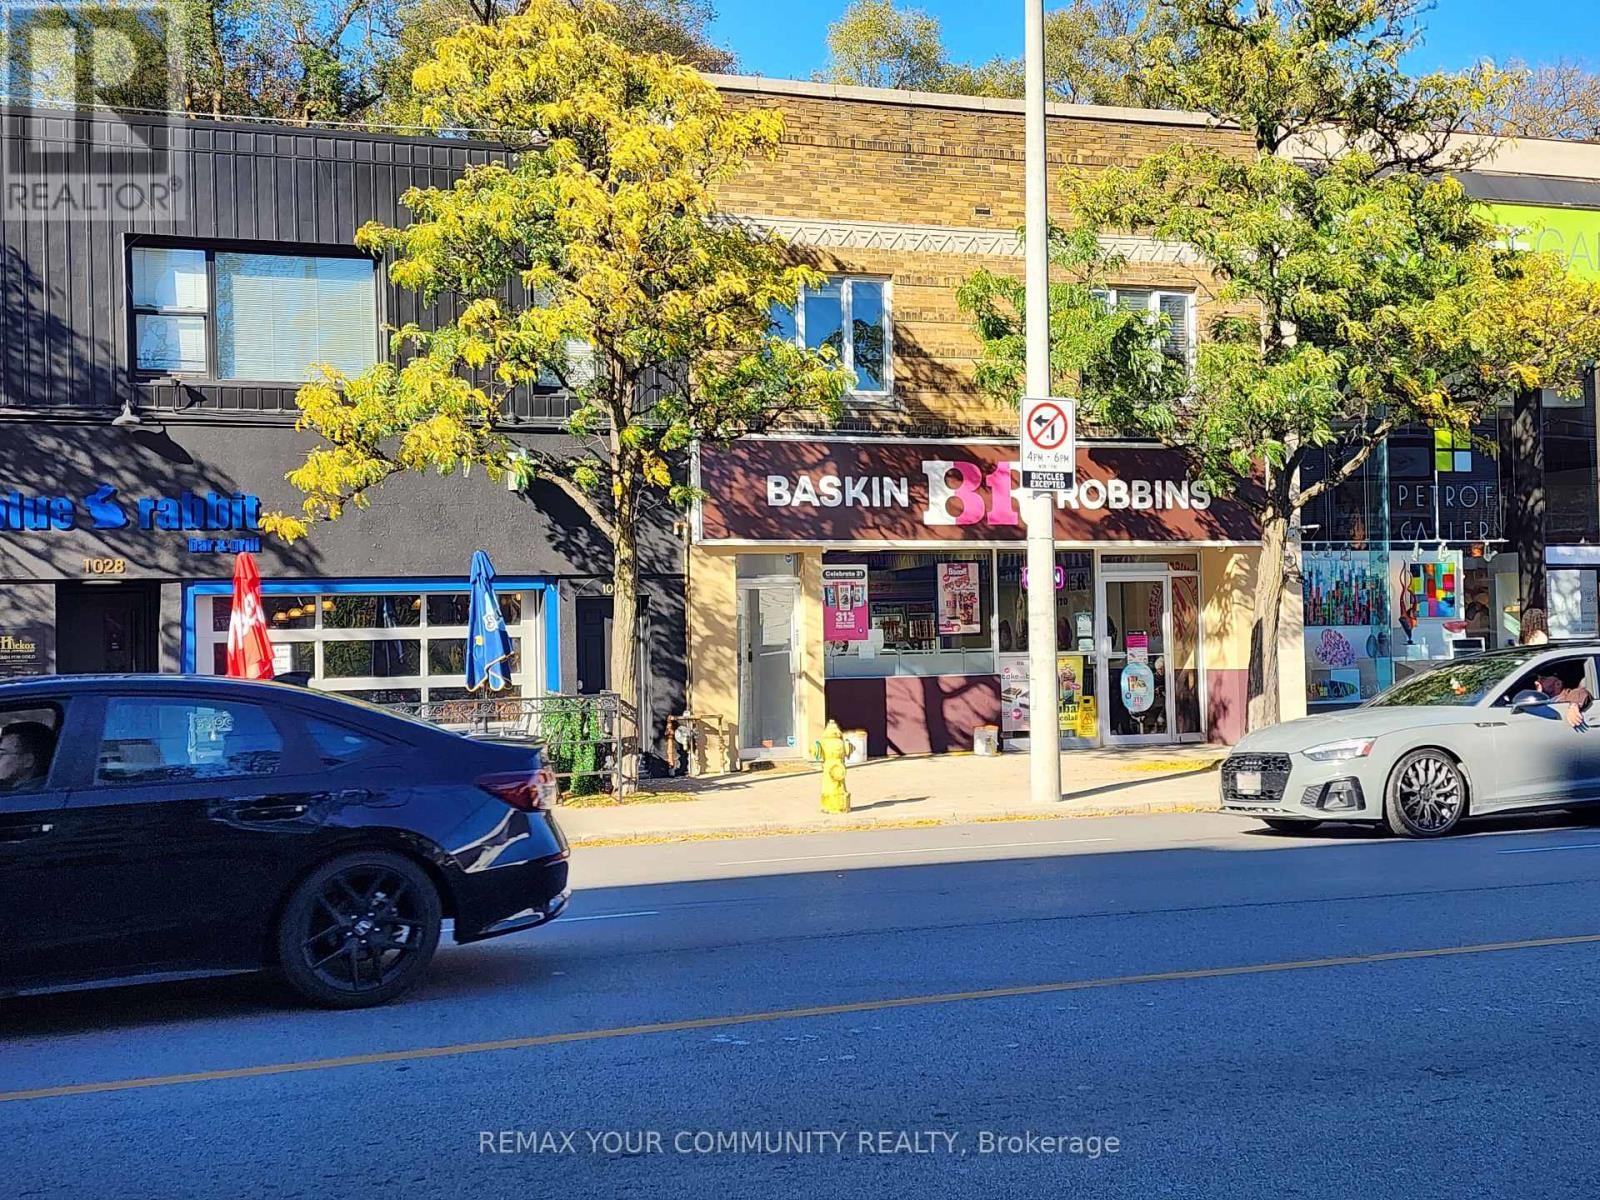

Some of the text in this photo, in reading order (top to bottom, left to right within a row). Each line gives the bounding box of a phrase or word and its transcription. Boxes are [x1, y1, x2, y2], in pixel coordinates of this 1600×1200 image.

[1030, 480, 1065, 489] EXCEPTED
[1031, 472, 1065, 481] BICYCLES
[766, 475, 909, 508] BASKIN
[1057, 479, 1212, 510] ROBBINS
[1399, 485, 1508, 508] PETROF
[139, 490, 262, 531] rabbit
[189, 536, 213, 552] bar
[230, 537, 262, 552] grill
[83, 558, 126, 574] 1028
[602, 584, 614, 594] 10
